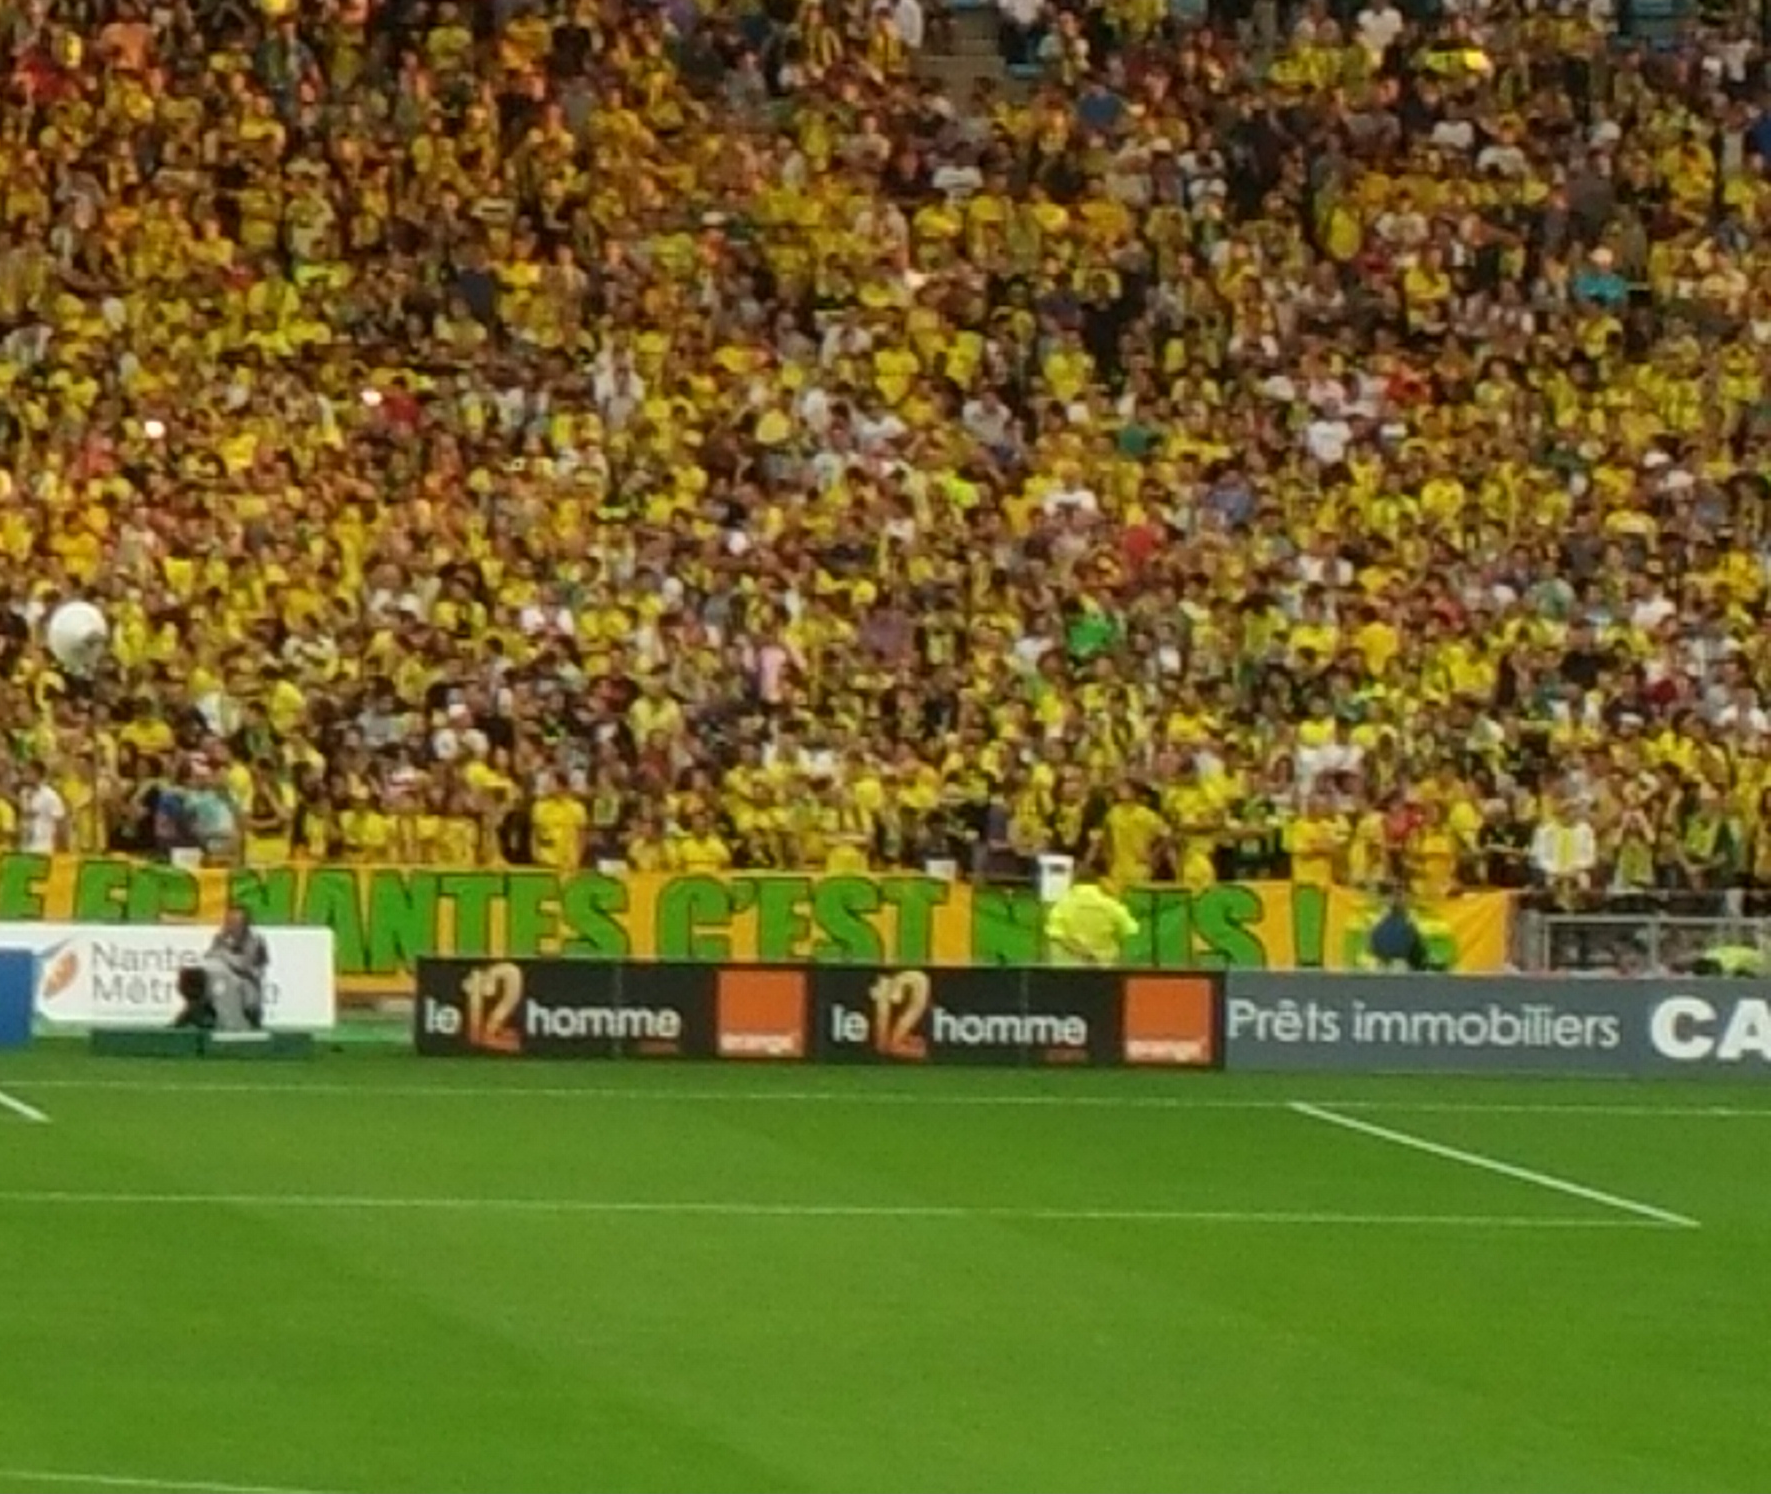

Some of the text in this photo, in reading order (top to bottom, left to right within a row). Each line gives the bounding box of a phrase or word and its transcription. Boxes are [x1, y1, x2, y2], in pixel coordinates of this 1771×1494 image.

[229, 866, 629, 974] NANTES
[658, 873, 949, 963] C'EST
[973, 884, 1267, 967] NUS
[424, 996, 460, 1035] le
[525, 998, 681, 1039] homme
[831, 1004, 869, 1043] le
[933, 1007, 1089, 1046] homme
[1229, 999, 1340, 1046] Prêts
[1352, 1000, 1620, 1049] immobiliers
